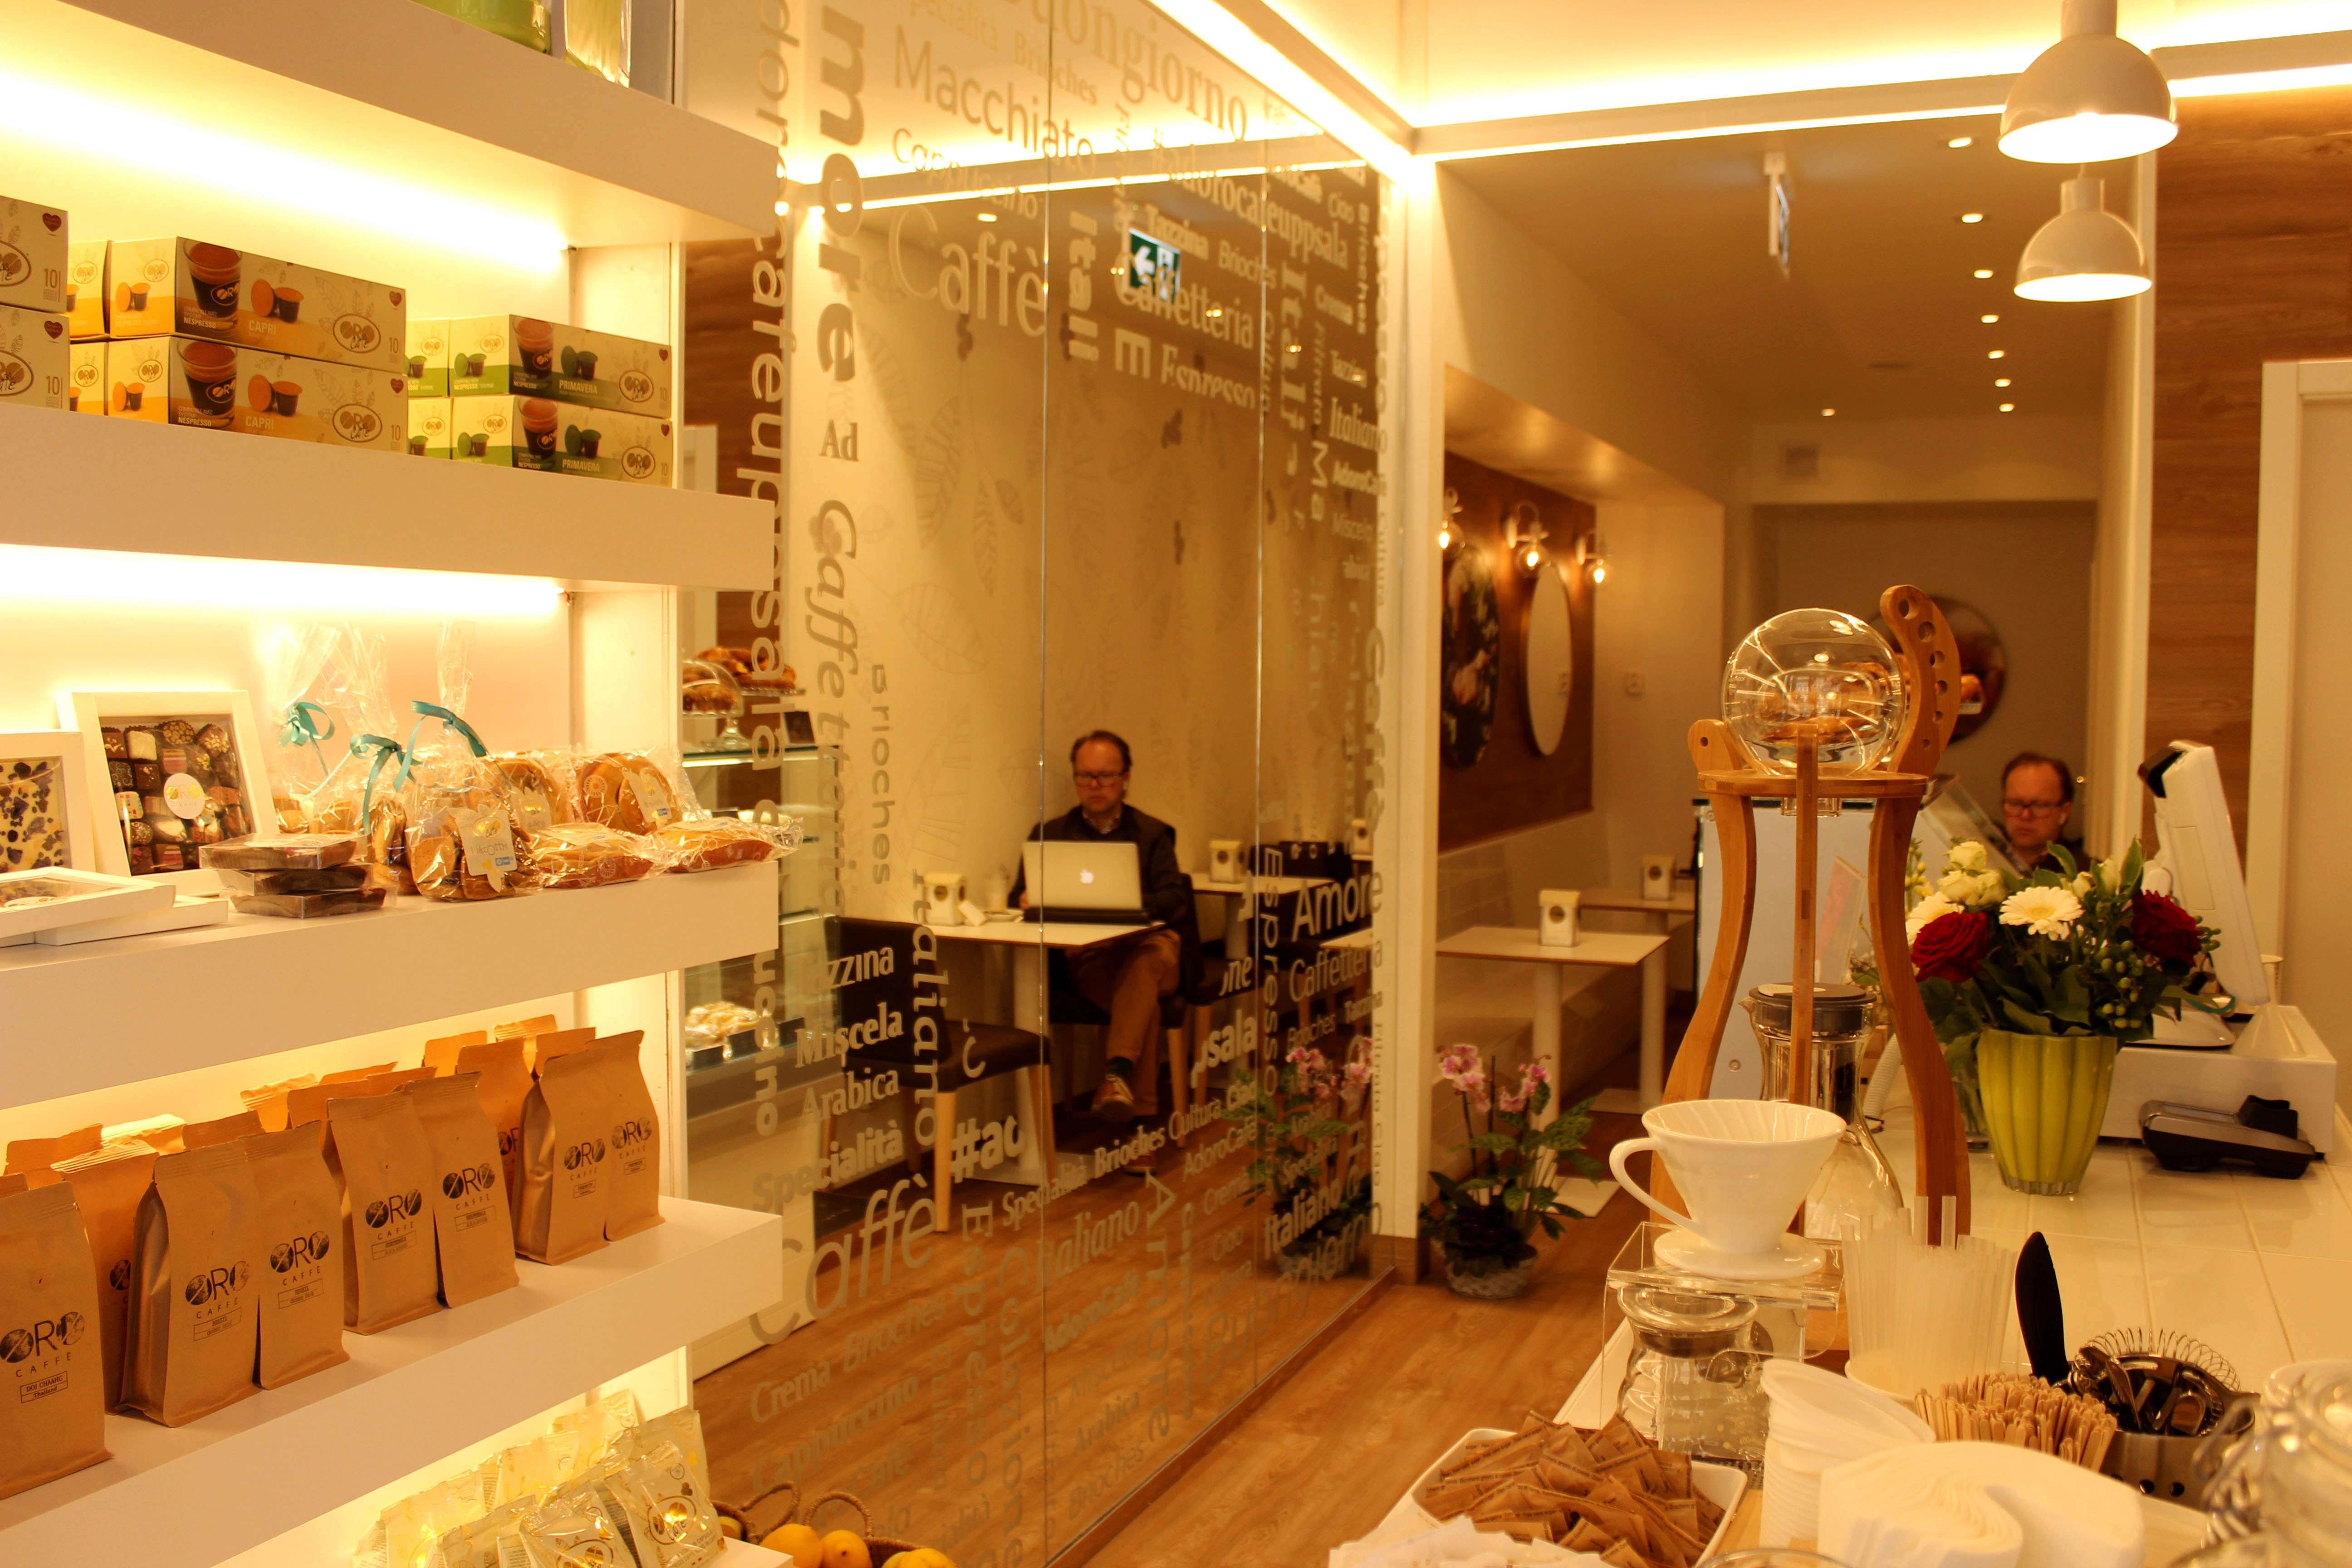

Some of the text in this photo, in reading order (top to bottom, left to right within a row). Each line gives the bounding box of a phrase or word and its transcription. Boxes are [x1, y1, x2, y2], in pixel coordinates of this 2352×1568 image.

[1145, 203, 1209, 260] Tazzina
[44, 269, 59, 289] 10
[888, 202, 1046, 337] Caffè
[1219, 240, 1277, 289] Brioches
[1113, 252, 1254, 350] Caffetteria
[183, 317, 216, 329] NESPRESSO
[248, 319, 276, 335] CAPRI
[389, 337, 399, 354] 10
[46, 376, 60, 396] 10
[514, 381, 538, 389] NESPRESSO
[559, 380, 598, 395] PRIMAVERA
[1329, 349, 1367, 387] Tazzina
[178, 416, 212, 427] NESPRESSO
[245, 416, 274, 430] CAPRI
[390, 425, 401, 441] 10
[818, 419, 861, 462] Ad
[1329, 396, 1388, 454] Italiano
[518, 461, 541, 470] NESPRESSO
[562, 458, 600, 473] PRIMAVERA
[1292, 871, 1383, 943] Amore
[812, 946, 895, 994] zzina
[1260, 848, 1284, 1097] Espresso
[911, 868, 950, 1147] Italiano
[795, 1002, 904, 1069] Miscela
[801, 1067, 900, 1122] Arabica
[564, 1138, 605, 1171] ORO
[611, 1117, 652, 1150] ORO
[442, 1162, 495, 1200] ORO
[751, 1119, 904, 1215] Specialità
[1002, 1155, 1087, 1231] Specialità
[1094, 1124, 1166, 1179] Brioches
[1168, 1098, 1223, 1141] Cultura
[365, 1189, 422, 1228] ORO
[1264, 1178, 1342, 1260] Italiano
[270, 1230, 330, 1273] ORO
[1036, 1200, 1140, 1295] Italiano
[185, 1260, 249, 1306] ORO
[1146, 1166, 1178, 1444] Amore
[0, 1311, 85, 1363] ORO
[750, 1292, 947, 1423] Crema Brioches
[26, 1385, 37, 1393] DOI
[33, 1386, 58, 1398] Thailand
